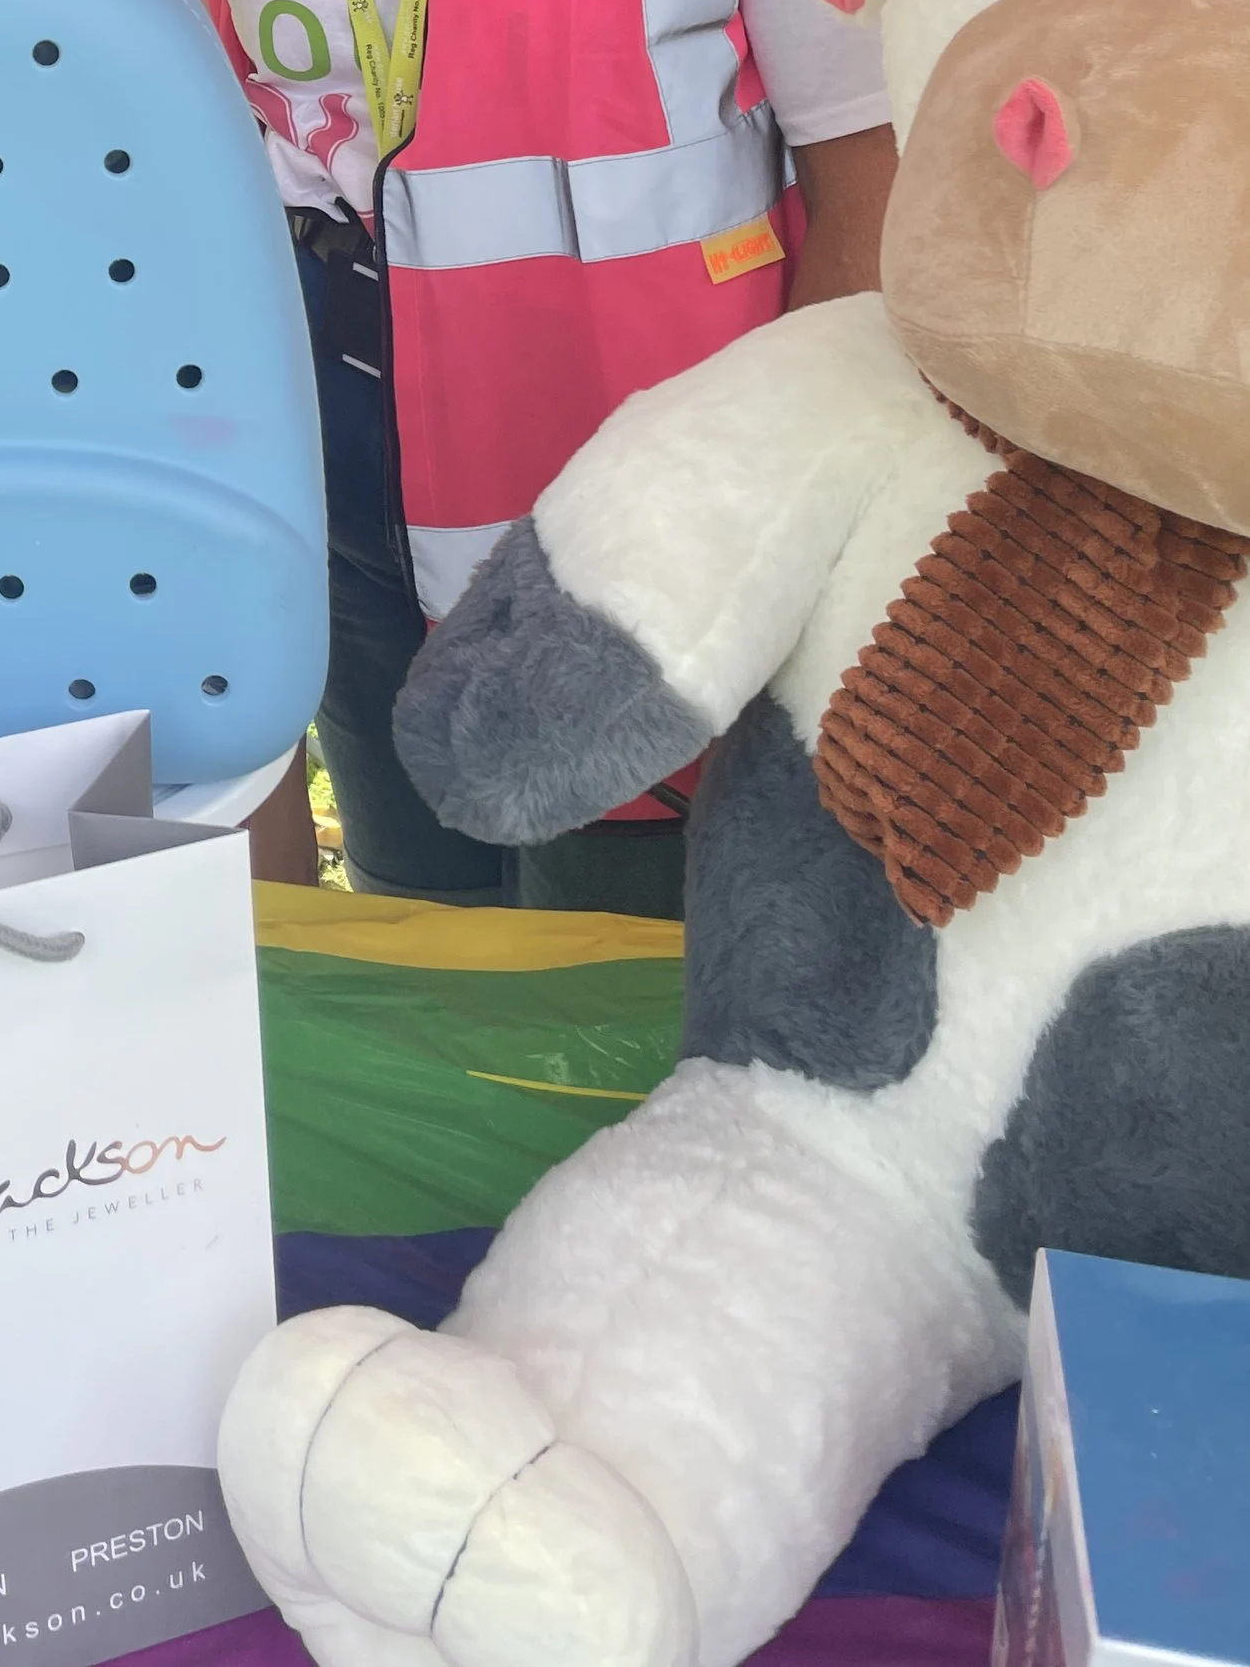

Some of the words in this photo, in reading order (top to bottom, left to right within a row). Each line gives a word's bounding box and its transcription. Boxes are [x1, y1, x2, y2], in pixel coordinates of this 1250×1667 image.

[410, 13, 420, 42] Charity
[365, 43, 373, 60] Reg
[369, 59, 381, 88] Charity
[407, 42, 417, 59] Reg
[9, 1217, 55, 1243] THE
[71, 1178, 205, 1225] JEWELLER
[69, 1509, 205, 1572] PRESTON
